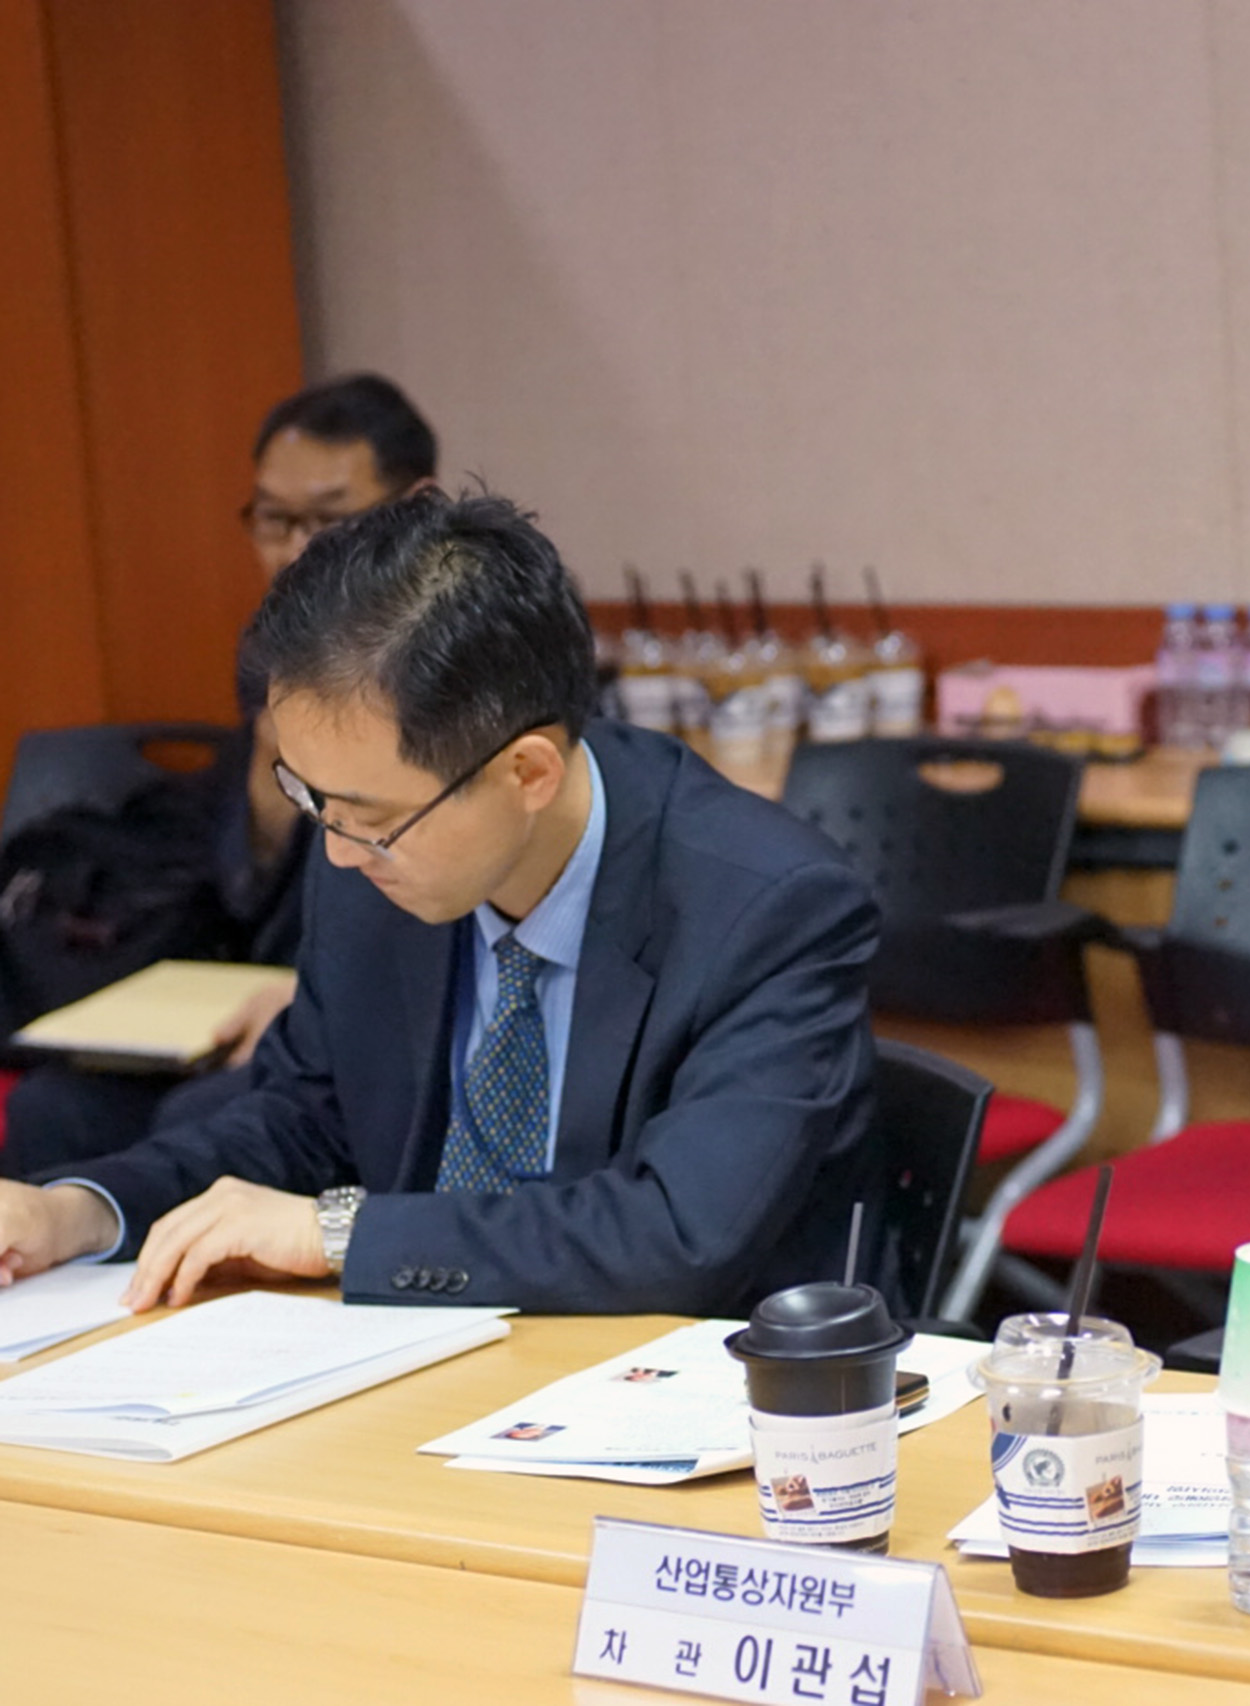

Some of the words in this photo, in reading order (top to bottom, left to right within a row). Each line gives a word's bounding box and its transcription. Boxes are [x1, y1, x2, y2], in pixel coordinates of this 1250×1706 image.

[775, 1450, 808, 1462] PARIS
[818, 1441, 877, 1461] BAGUETTE
[655, 1555, 856, 1618] 산업통상자원부
